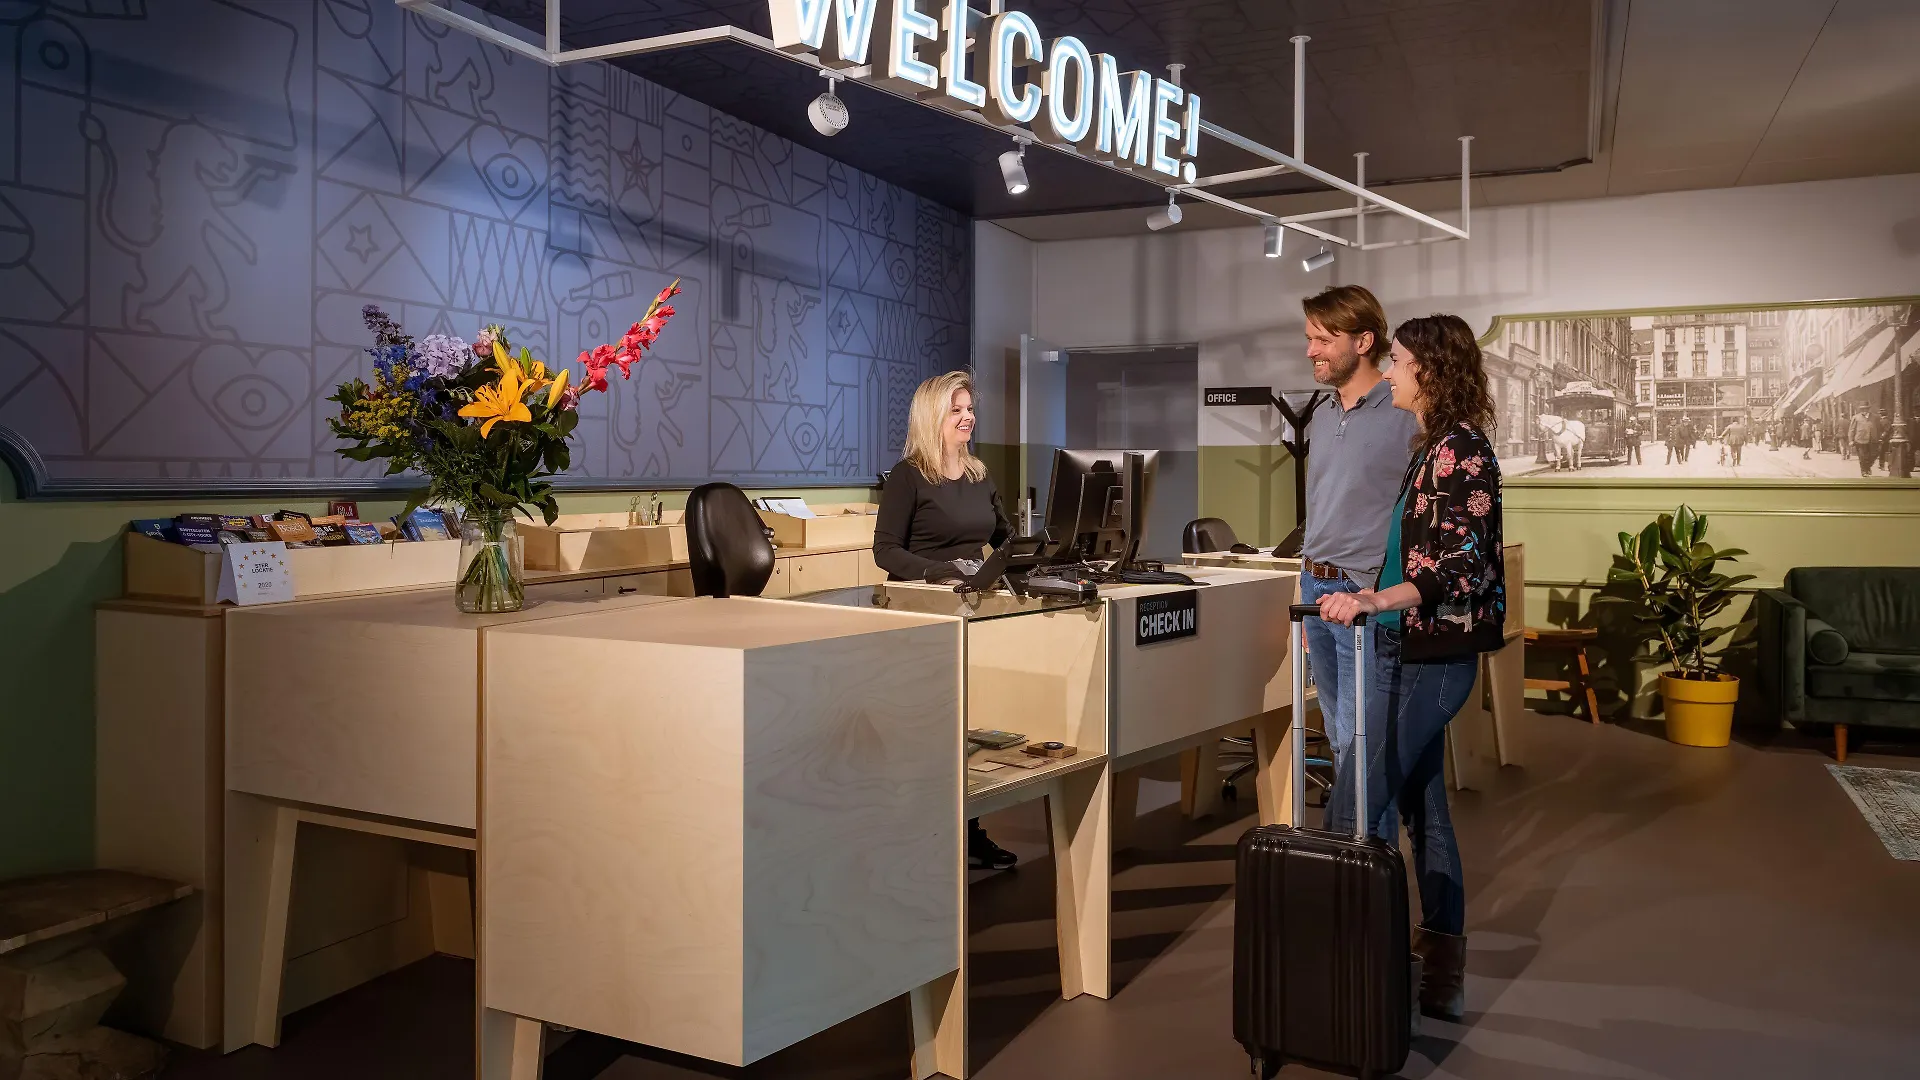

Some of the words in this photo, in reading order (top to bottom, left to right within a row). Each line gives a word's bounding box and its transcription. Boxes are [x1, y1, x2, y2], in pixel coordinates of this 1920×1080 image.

[1207, 393, 1237, 403] OFFICE
[1139, 600, 1168, 612] RECEPTION
[1140, 610, 1180, 638] CHECK
[1182, 608, 1194, 630] IN
